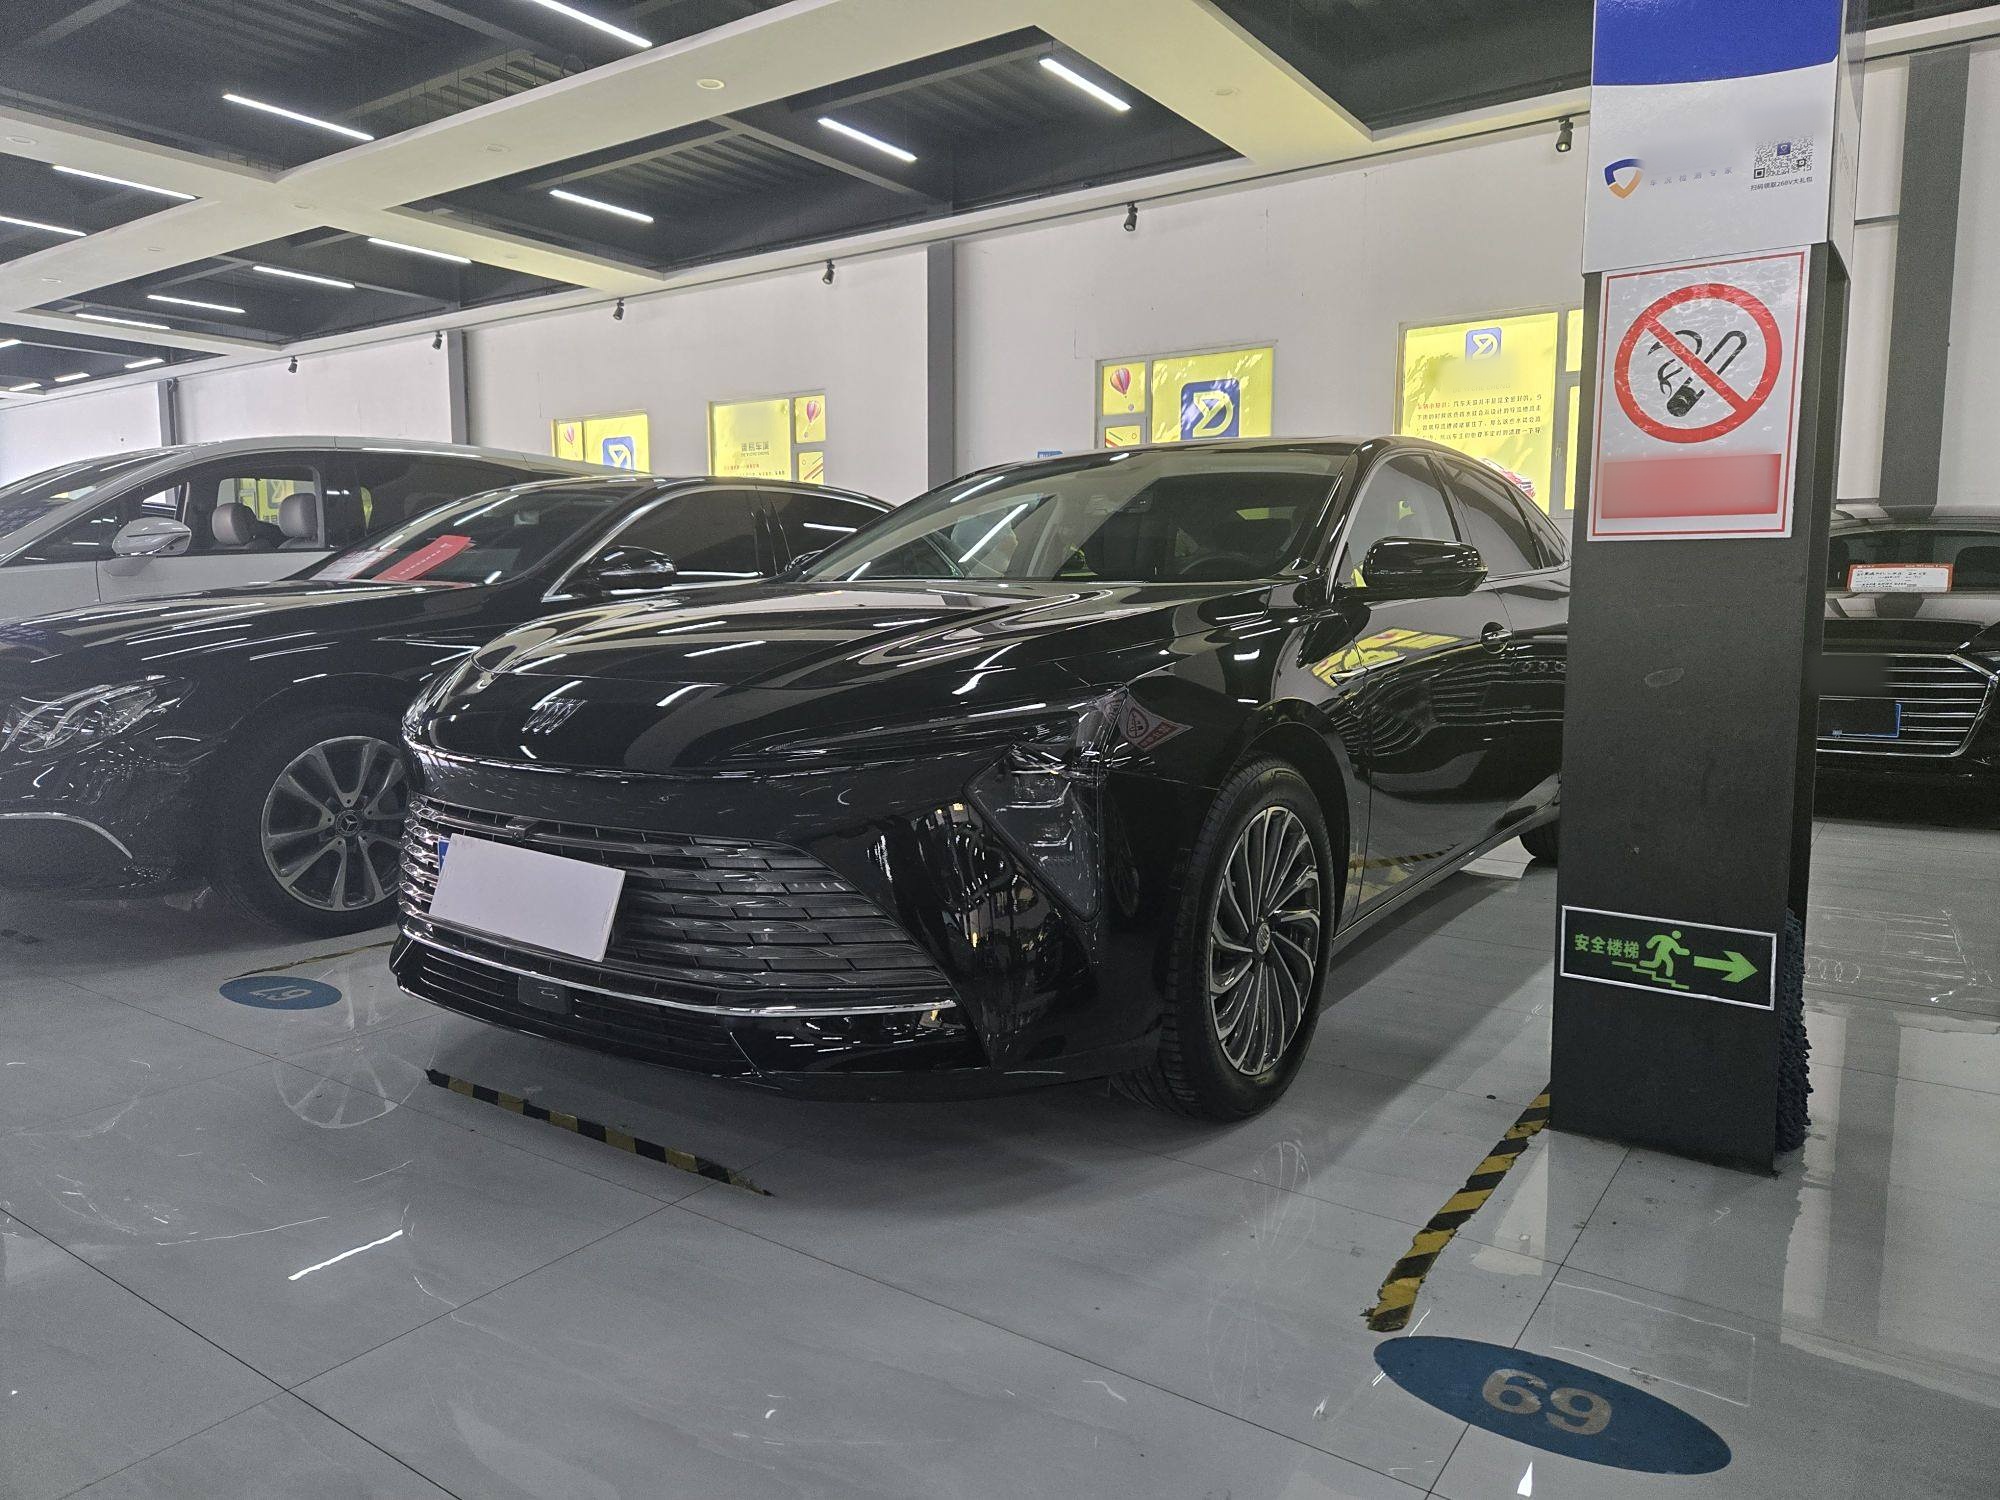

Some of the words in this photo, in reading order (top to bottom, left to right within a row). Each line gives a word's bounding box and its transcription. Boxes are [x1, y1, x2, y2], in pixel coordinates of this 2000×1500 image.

[1575, 934, 1640, 959] 安全楼梯
[1482, 1369, 1613, 1435] 69
